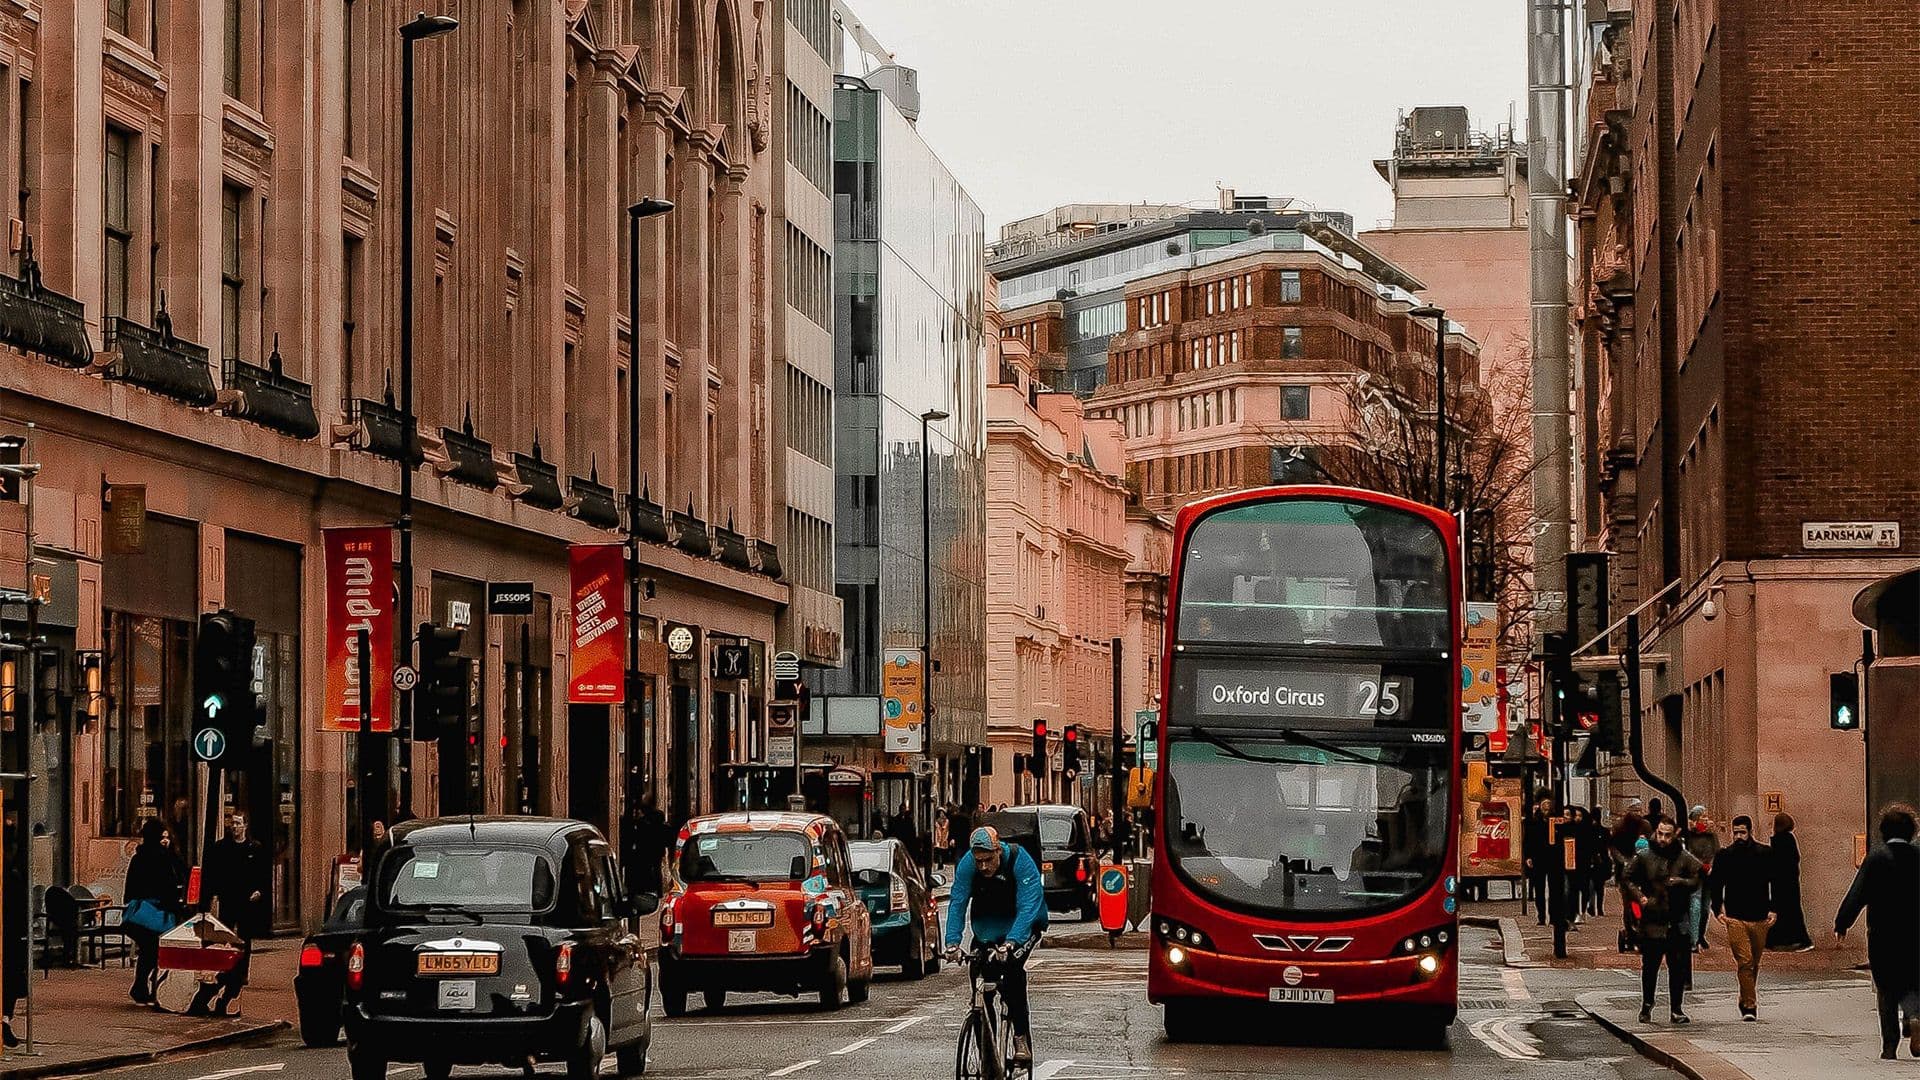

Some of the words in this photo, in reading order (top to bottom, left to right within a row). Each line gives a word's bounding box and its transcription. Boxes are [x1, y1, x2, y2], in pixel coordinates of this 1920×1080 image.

[1807, 530, 1874, 541] EARNSHAW
[344, 542, 356, 551] WE
[358, 542, 373, 551] ARE
[494, 593, 531, 604] JESSOPS
[575, 590, 603, 612] WHERE
[575, 599, 607, 624] HISTORY
[575, 615, 601, 636] MEETS
[575, 616, 619, 648] INNOVATION
[396, 672, 415, 685] 20
[1212, 684, 1270, 705] Oxford
[1275, 686, 1325, 707] Circus
[1359, 680, 1400, 716] 25
[1279, 988, 1300, 1001] BJ11
[1303, 989, 1325, 1001] DTV
